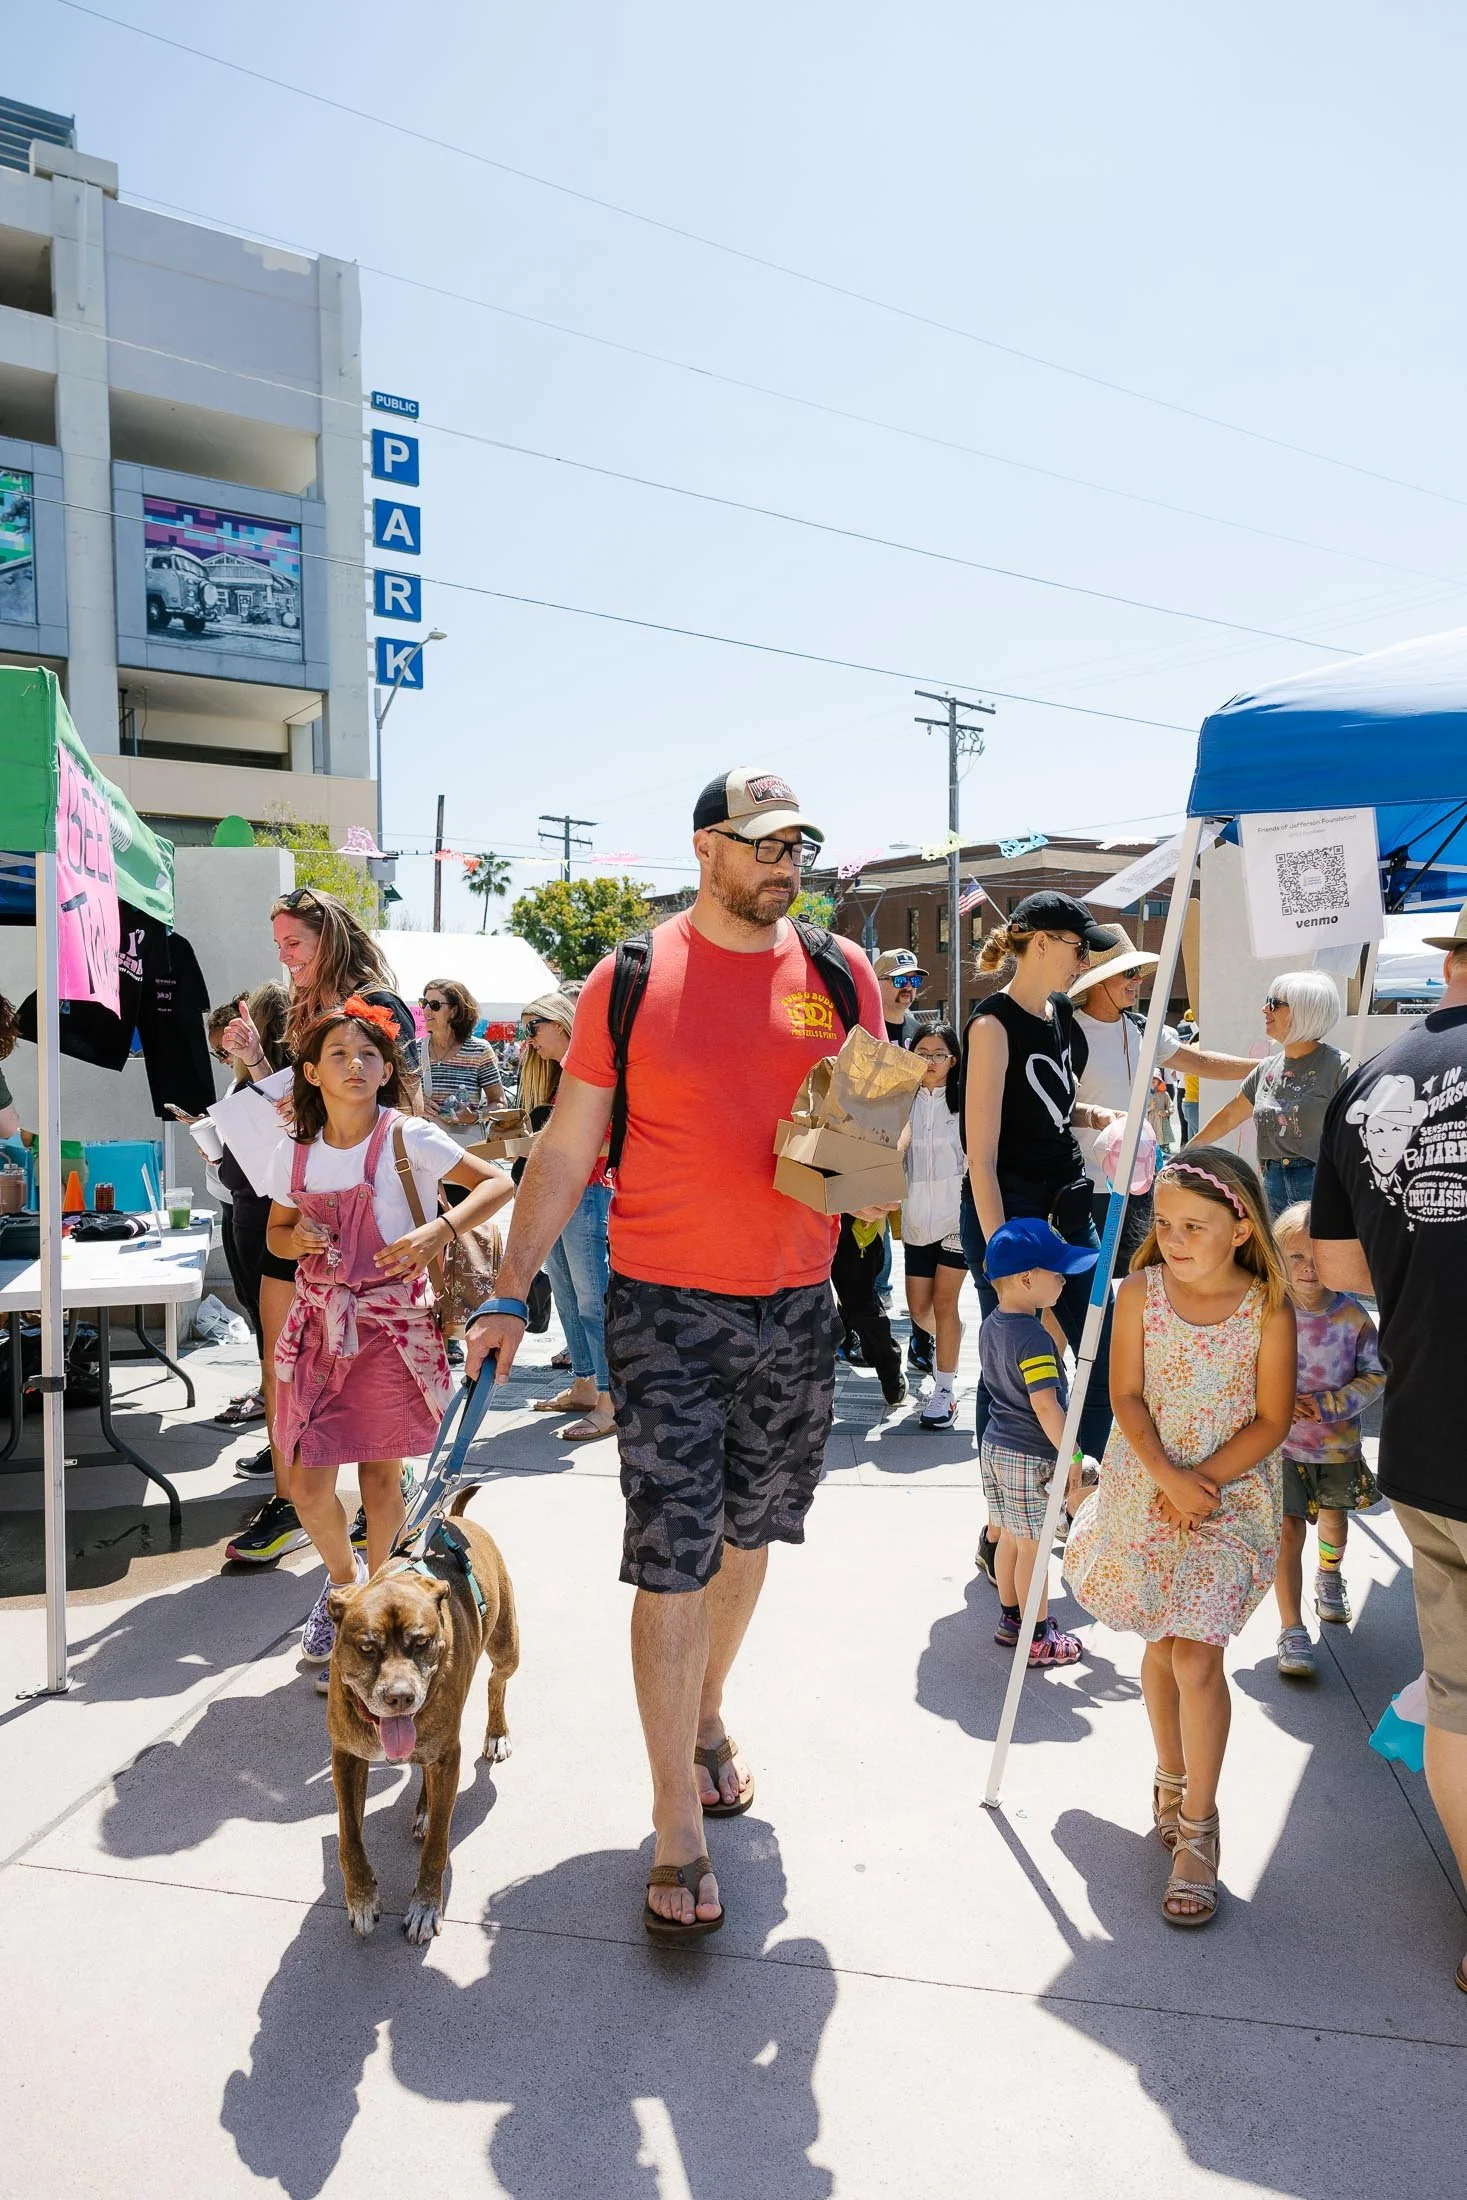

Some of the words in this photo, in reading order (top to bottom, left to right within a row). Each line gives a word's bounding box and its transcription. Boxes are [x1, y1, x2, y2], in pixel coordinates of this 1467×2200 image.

[376, 395, 416, 413] PUBLIC
[382, 437, 416, 682] PARK
[1289, 820, 1321, 829] Jefferson
[1321, 814, 1357, 824] Foundation
[1296, 916, 1339, 928] venmo
[1442, 1066, 1462, 1090] IN
[1420, 1120, 1467, 1137] SENSATIO
[1448, 1130, 1467, 1139] MEA
[1424, 1189, 1467, 1207] CLASSI
[1422, 1207, 1445, 1215] CUTS
